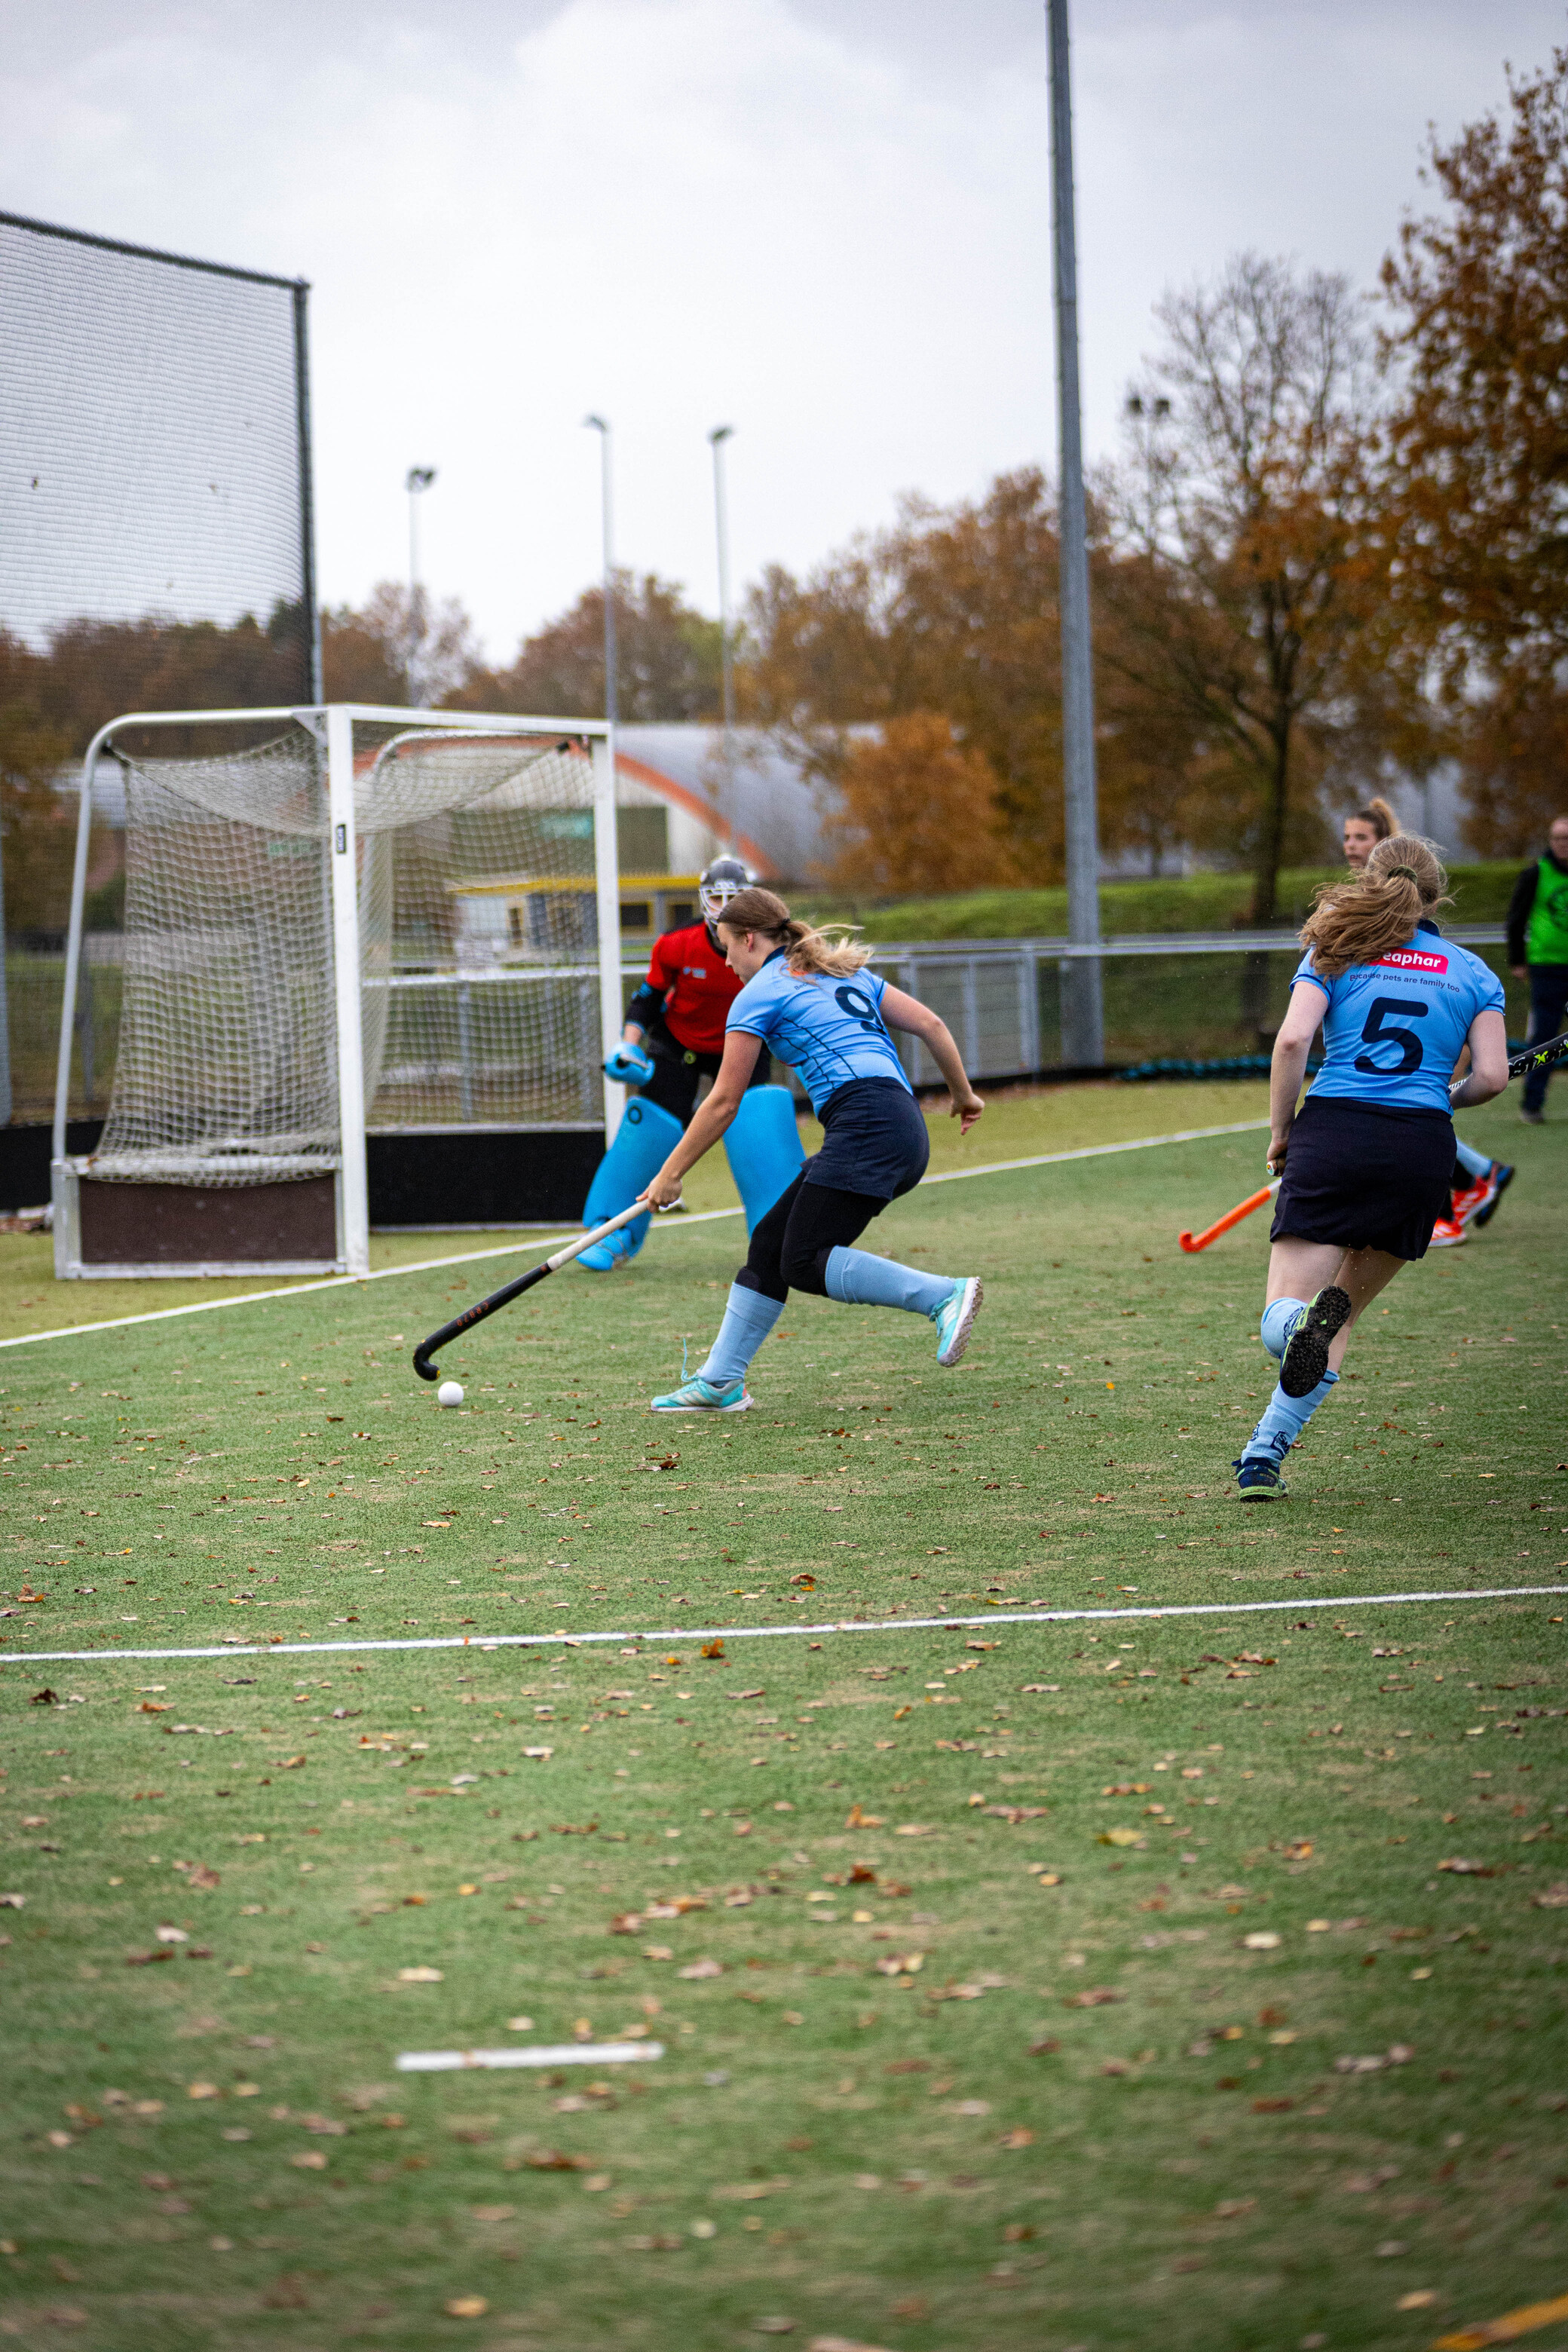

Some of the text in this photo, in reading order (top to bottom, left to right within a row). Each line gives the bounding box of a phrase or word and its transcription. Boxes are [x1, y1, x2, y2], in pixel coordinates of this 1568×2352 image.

[1381, 951, 1441, 968] eaphar
[1383, 974, 1401, 982] pets
[1420, 978, 1446, 989] family
[1447, 983, 1460, 993] too
[835, 986, 887, 1035] 9
[1354, 997, 1429, 1076] 5
